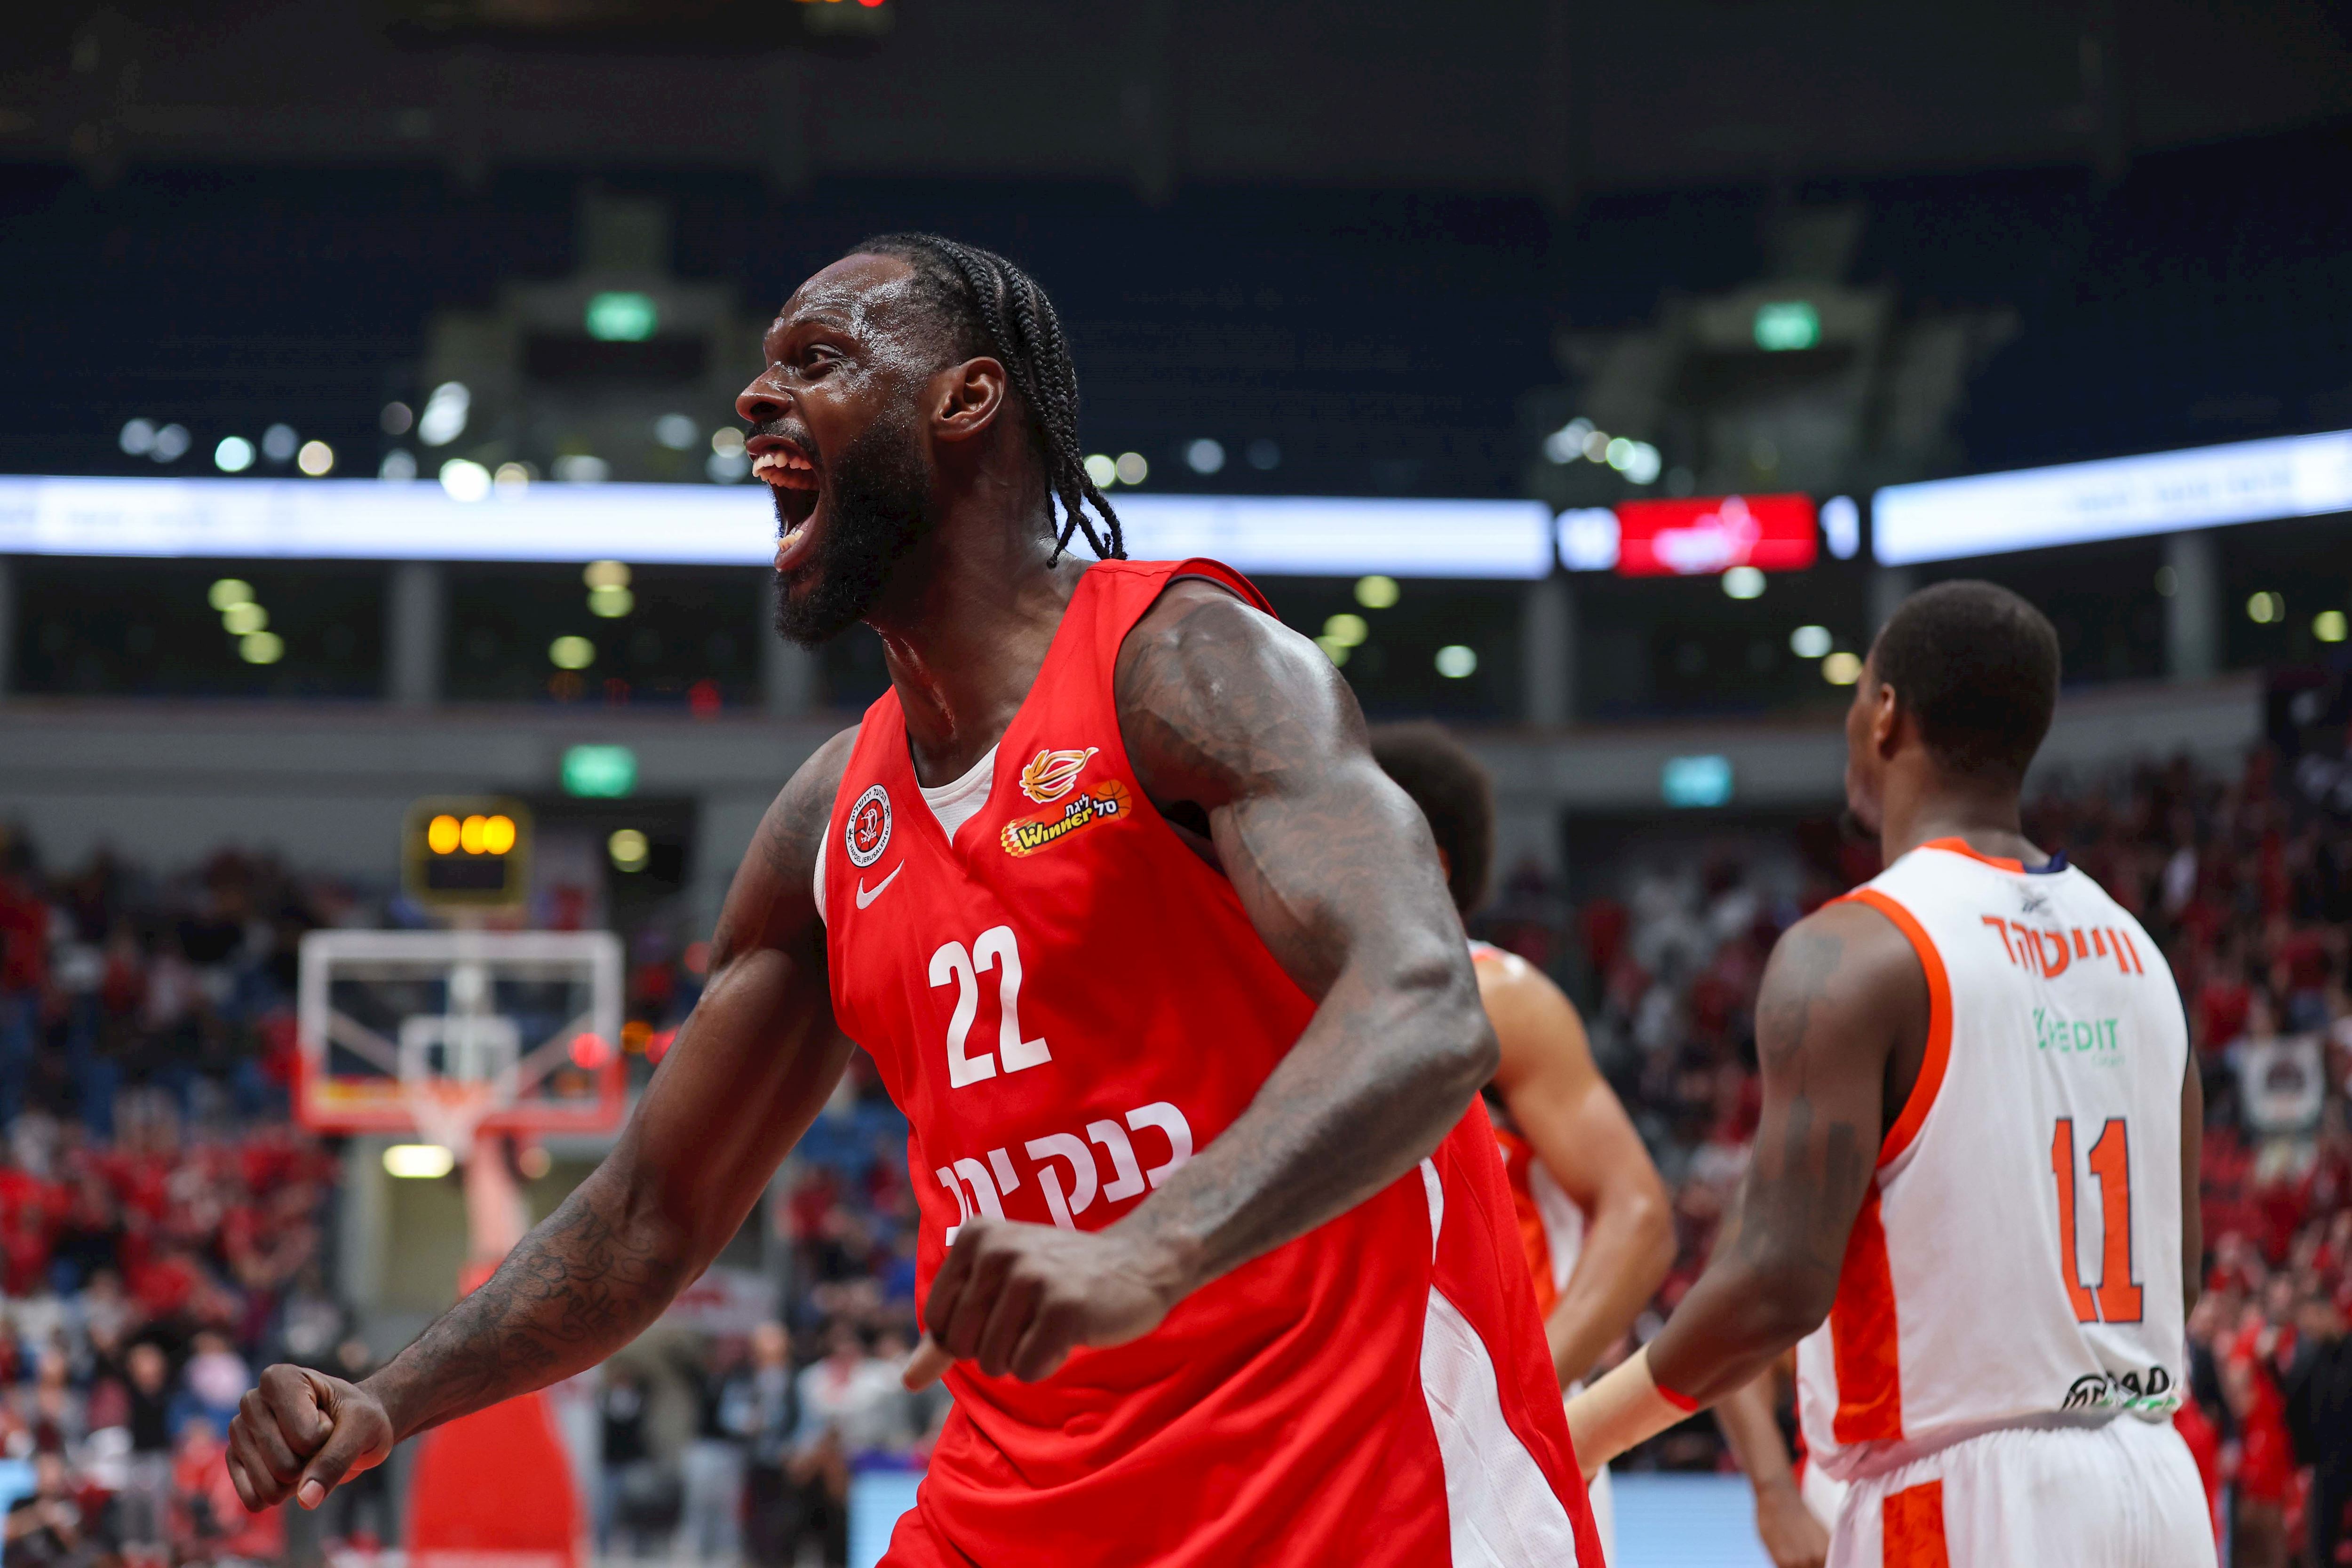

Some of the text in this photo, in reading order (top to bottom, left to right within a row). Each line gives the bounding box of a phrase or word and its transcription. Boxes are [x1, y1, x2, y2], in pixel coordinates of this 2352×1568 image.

[851, 788, 887, 822] הפועל ירושלים
[1065, 794, 1090, 818] ליגת
[1093, 800, 1118, 816] סל
[1018, 807, 1093, 848] Winner
[849, 844, 861, 863] HAPOEL
[861, 836, 887, 864] JERUSALEM
[929, 925, 1052, 1089] 22
[2051, 1117, 2143, 1324] 11
